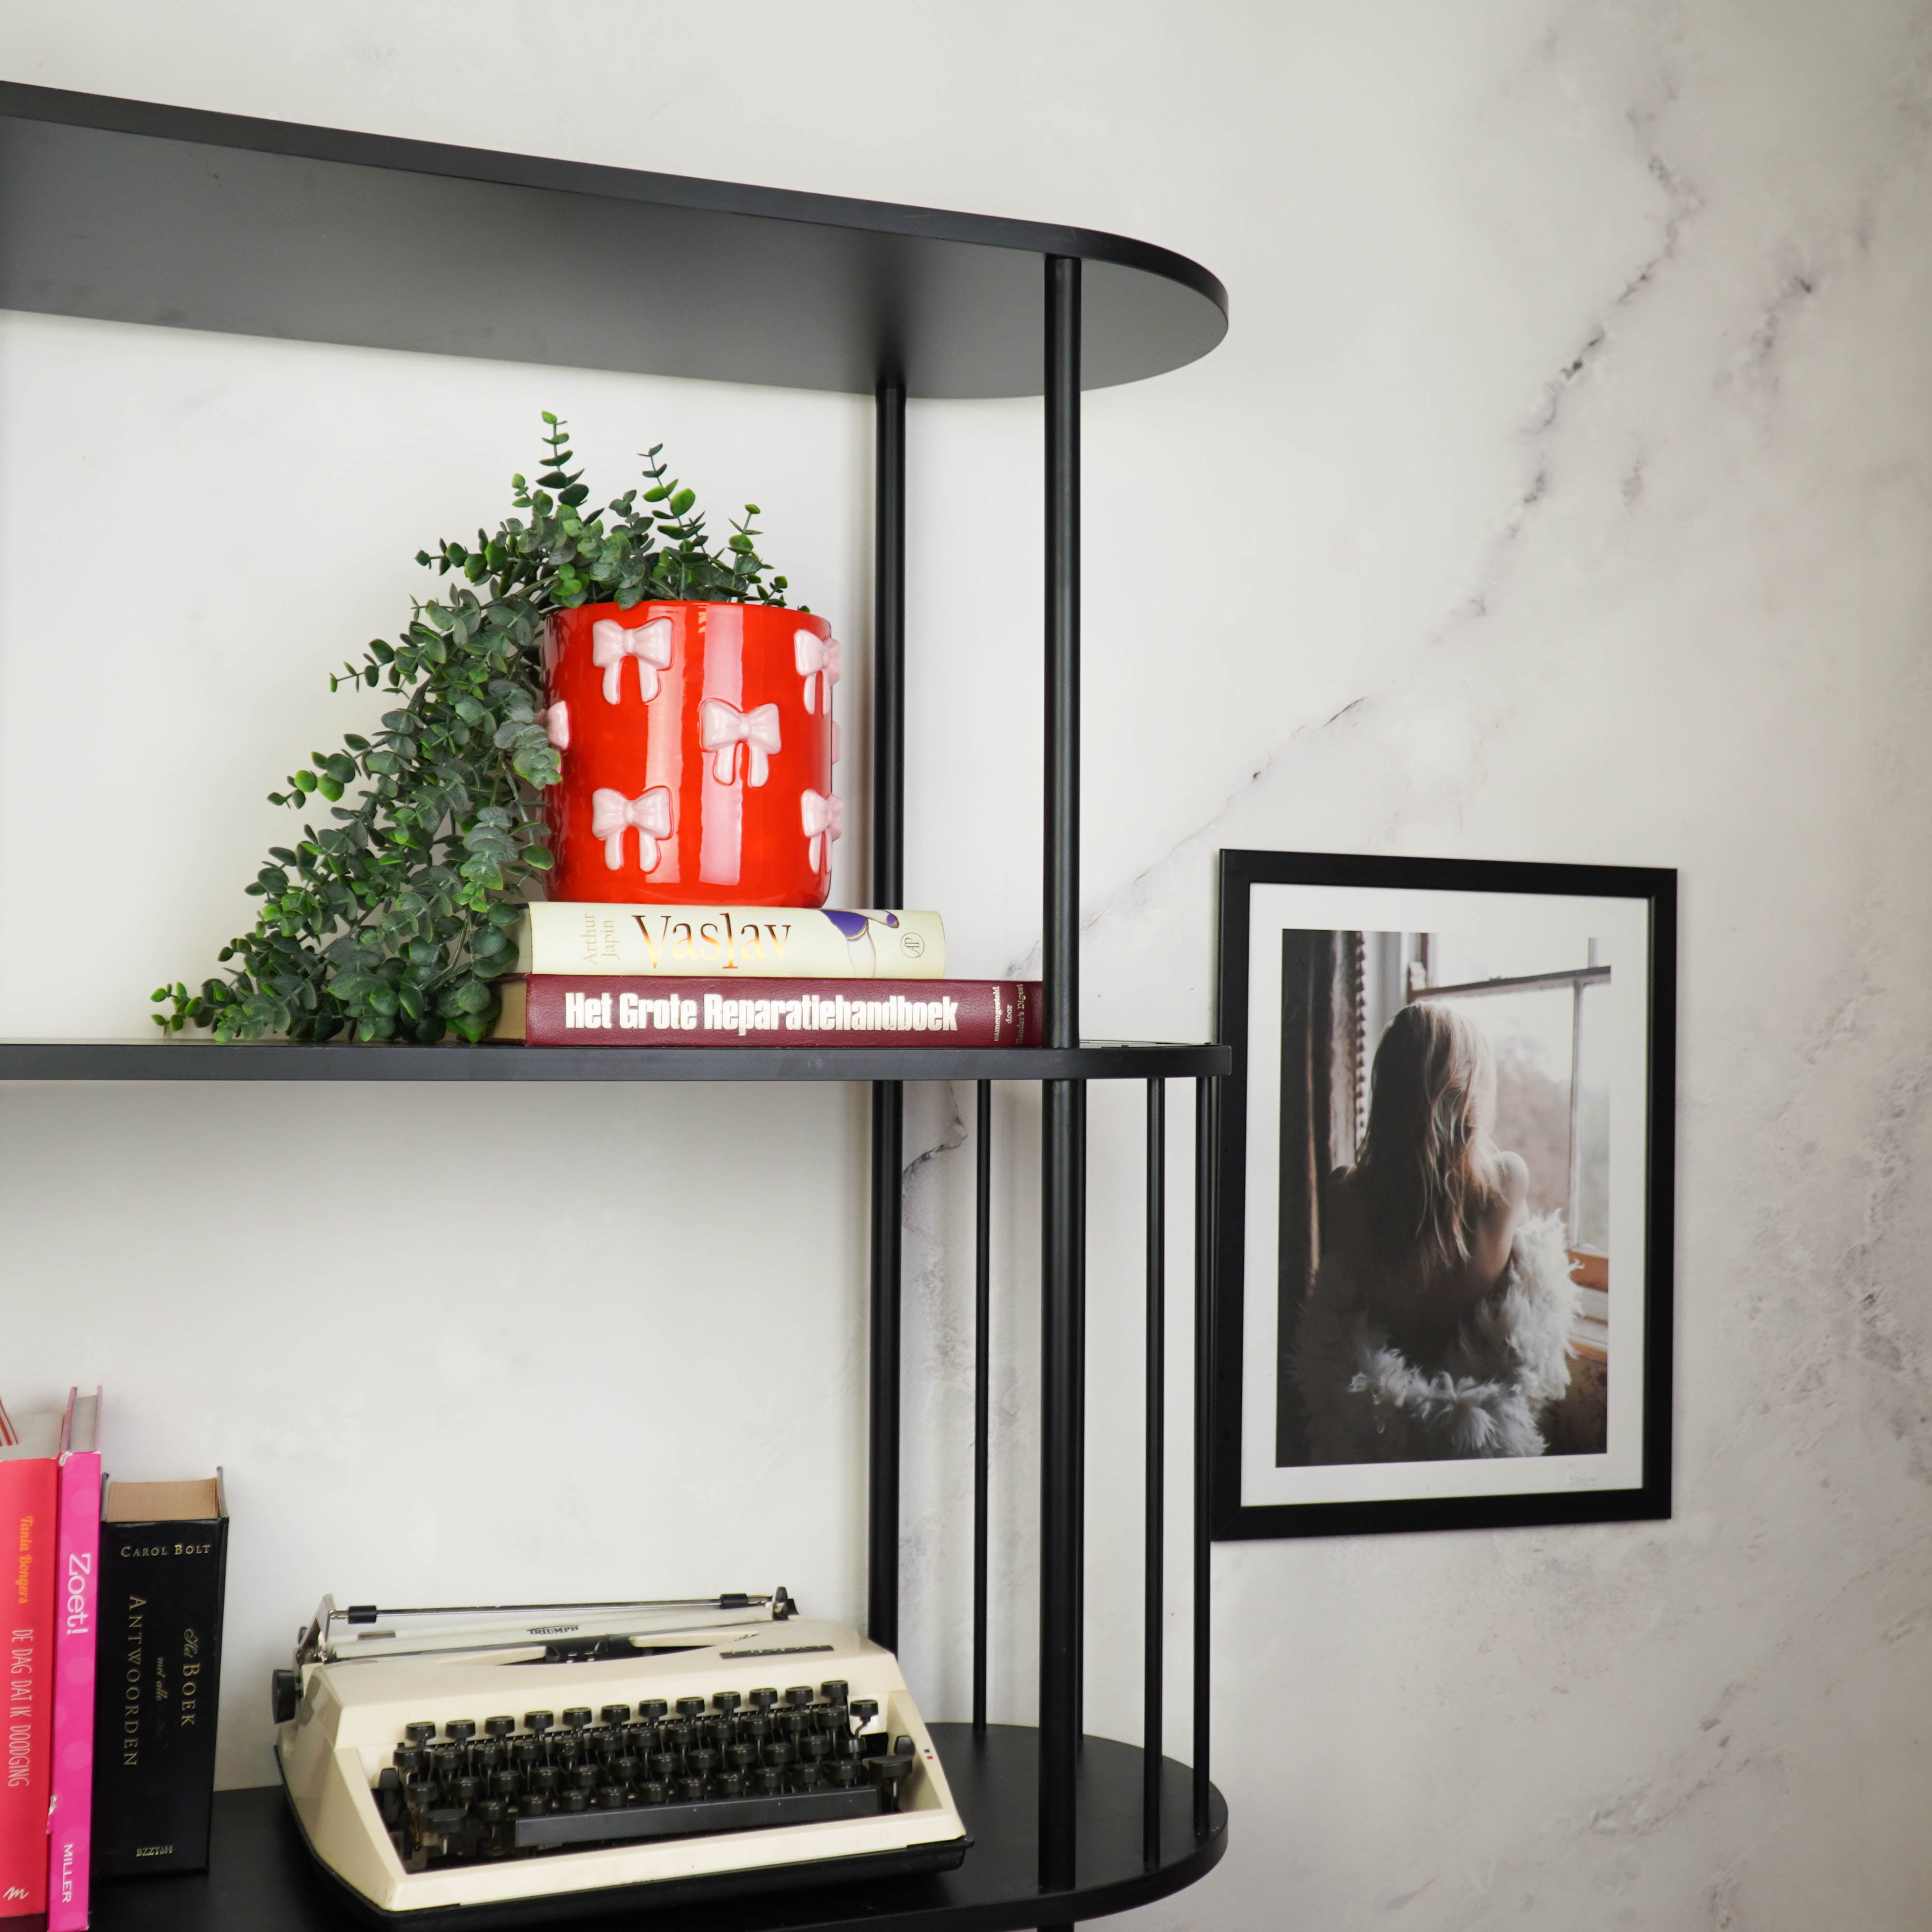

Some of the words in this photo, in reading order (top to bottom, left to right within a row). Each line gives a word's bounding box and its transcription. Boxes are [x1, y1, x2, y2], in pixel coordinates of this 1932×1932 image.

[582, 913, 597, 965] Arthur
[601, 919, 620, 960] Japin
[631, 912, 791, 968] Vaslav
[565, 993, 612, 1029] Het
[619, 993, 696, 1030] Grote
[703, 994, 958, 1036] Reparatiehandboek
[992, 986, 1002, 1041] samengesteld
[1016, 984, 1026, 1009] Digest
[20, 1516, 33, 1551] Tania
[121, 1546, 168, 1557] CAROL
[174, 1545, 210, 1555] BOLT
[15, 1555, 32, 1604] Bongers
[67, 1552, 91, 1635] Zoet!
[12, 1629, 33, 1642] DE
[527, 1625, 580, 1634] TRIUMPH
[11, 1648, 33, 1674] DAG
[124, 1594, 146, 1765] ANTWOORDEN
[156, 1656, 166, 1678] met
[10, 1680, 32, 1701] DAT
[155, 1681, 168, 1701] alle
[181, 1662, 200, 1727] BOEK
[10, 1706, 31, 1718] IK
[8, 1725, 31, 1787] DOODGING
[62, 1843, 73, 1903] MILLER
